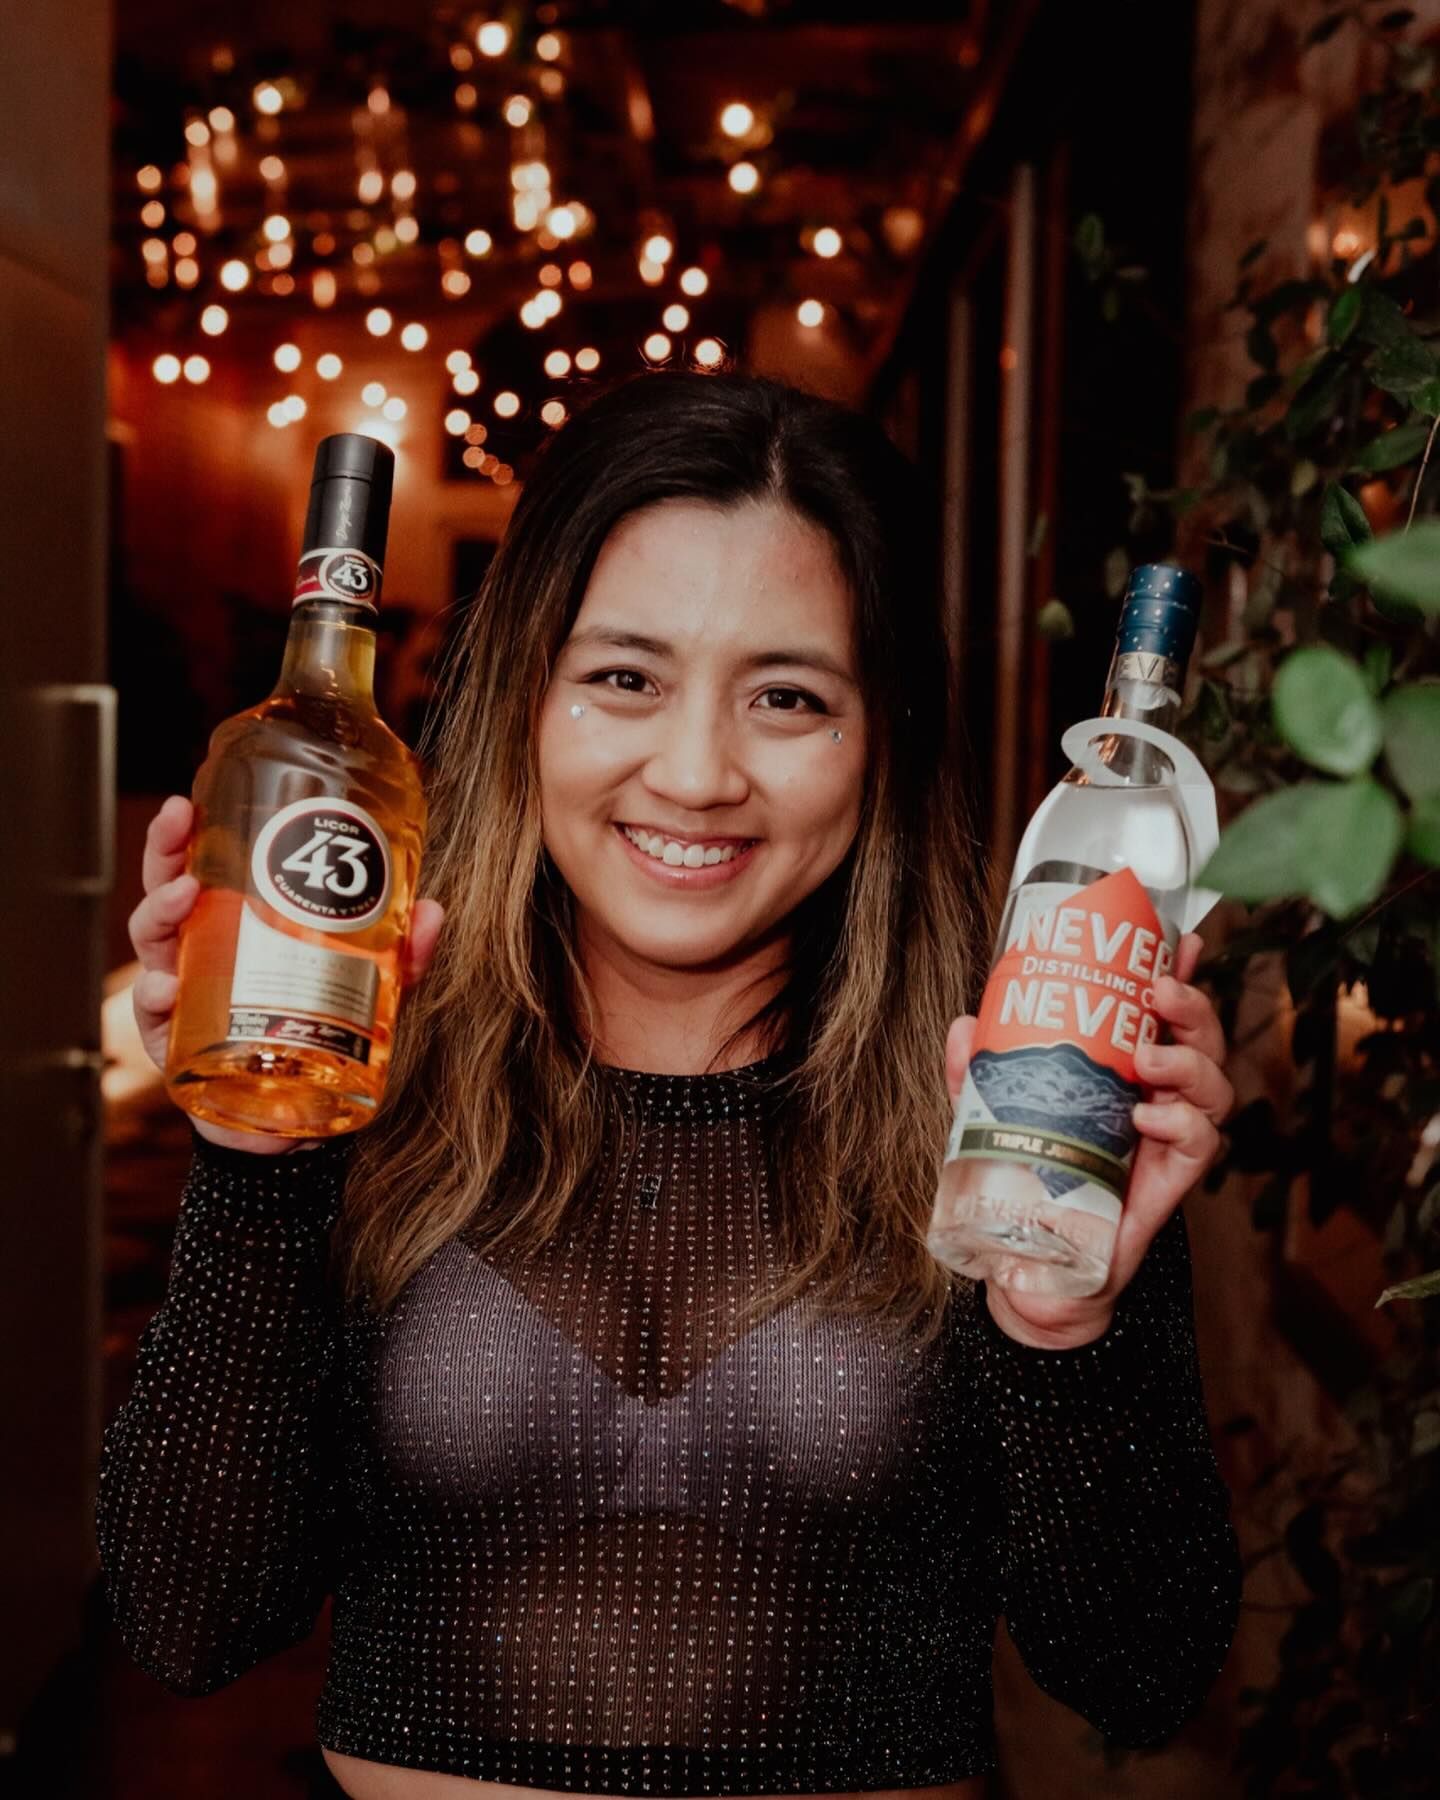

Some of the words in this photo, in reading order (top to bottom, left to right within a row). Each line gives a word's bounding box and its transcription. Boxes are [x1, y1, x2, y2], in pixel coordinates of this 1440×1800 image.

[331, 560, 369, 591] 43
[313, 817, 360, 835] LICOR
[281, 829, 371, 898] 43
[273, 873, 338, 916] CUARENTA
[991, 1131, 1045, 1154] TRIPLE
